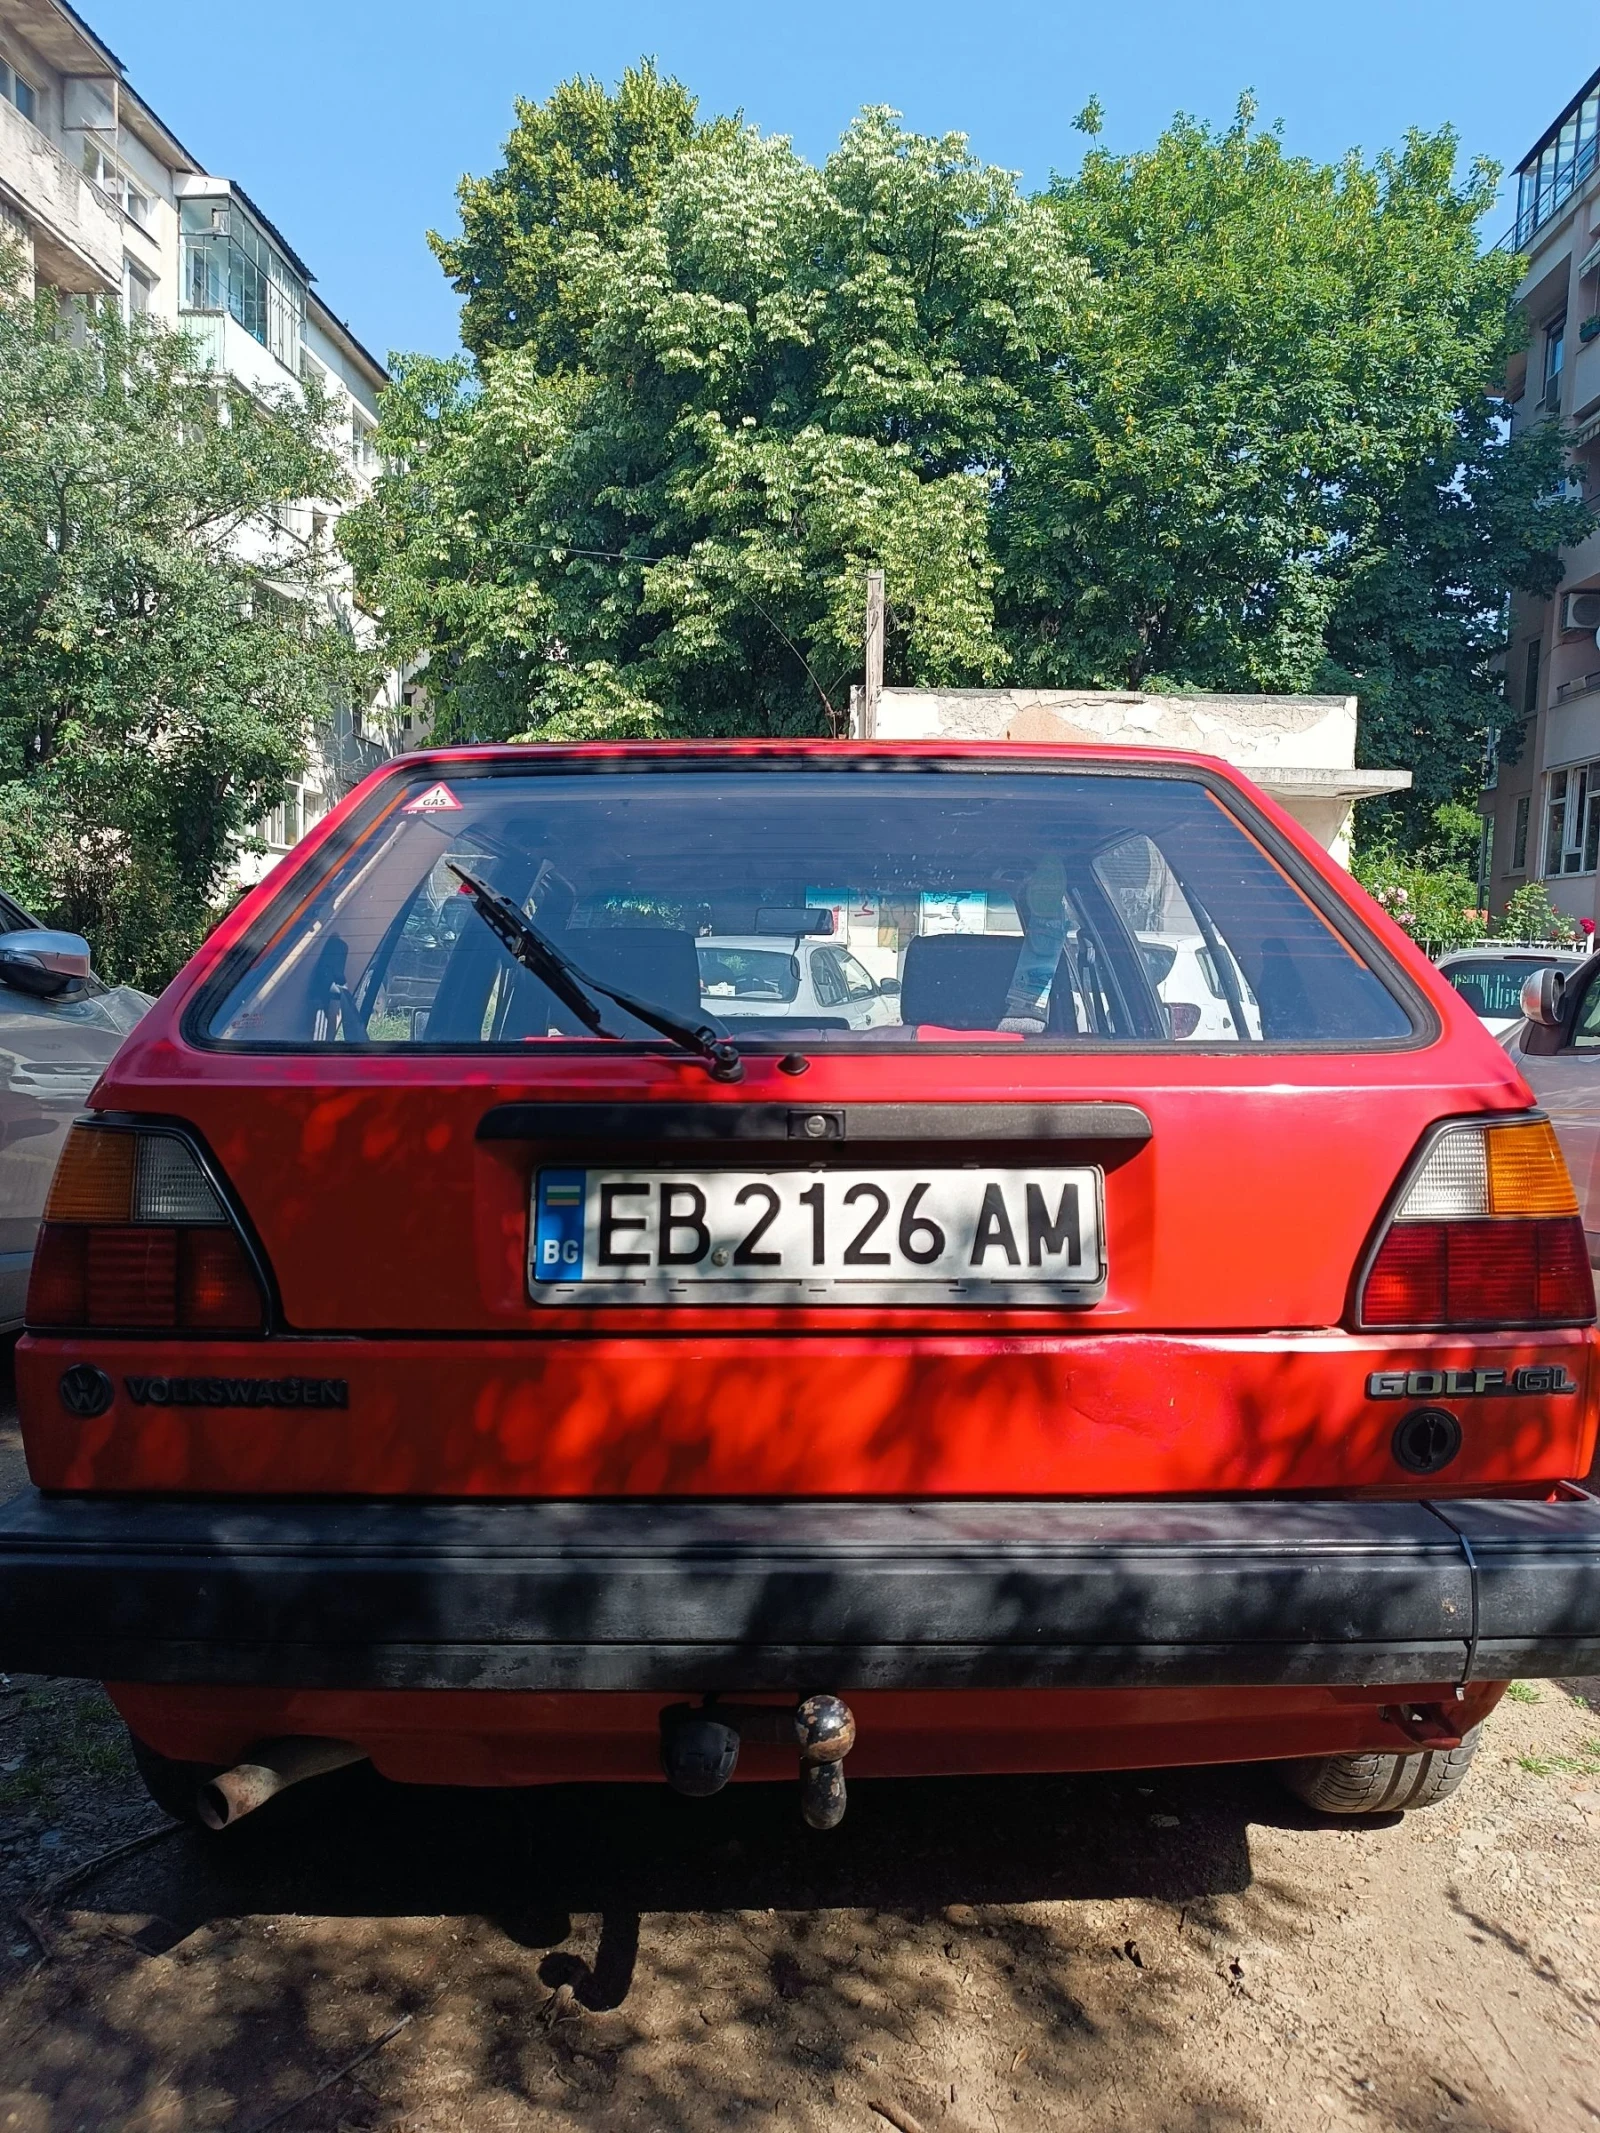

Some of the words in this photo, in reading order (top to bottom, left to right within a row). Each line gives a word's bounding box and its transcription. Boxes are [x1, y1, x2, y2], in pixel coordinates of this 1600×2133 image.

[423, 798, 446, 806] GAS
[598, 1182, 711, 1266] EB
[733, 1182, 946, 1266] 2126
[969, 1182, 1082, 1267] AM
[542, 1239, 579, 1265] BG
[126, 1377, 347, 1406] VOLKSWAGEN
[1368, 1369, 1505, 1396] GOLF
[1516, 1366, 1578, 1394] GL
